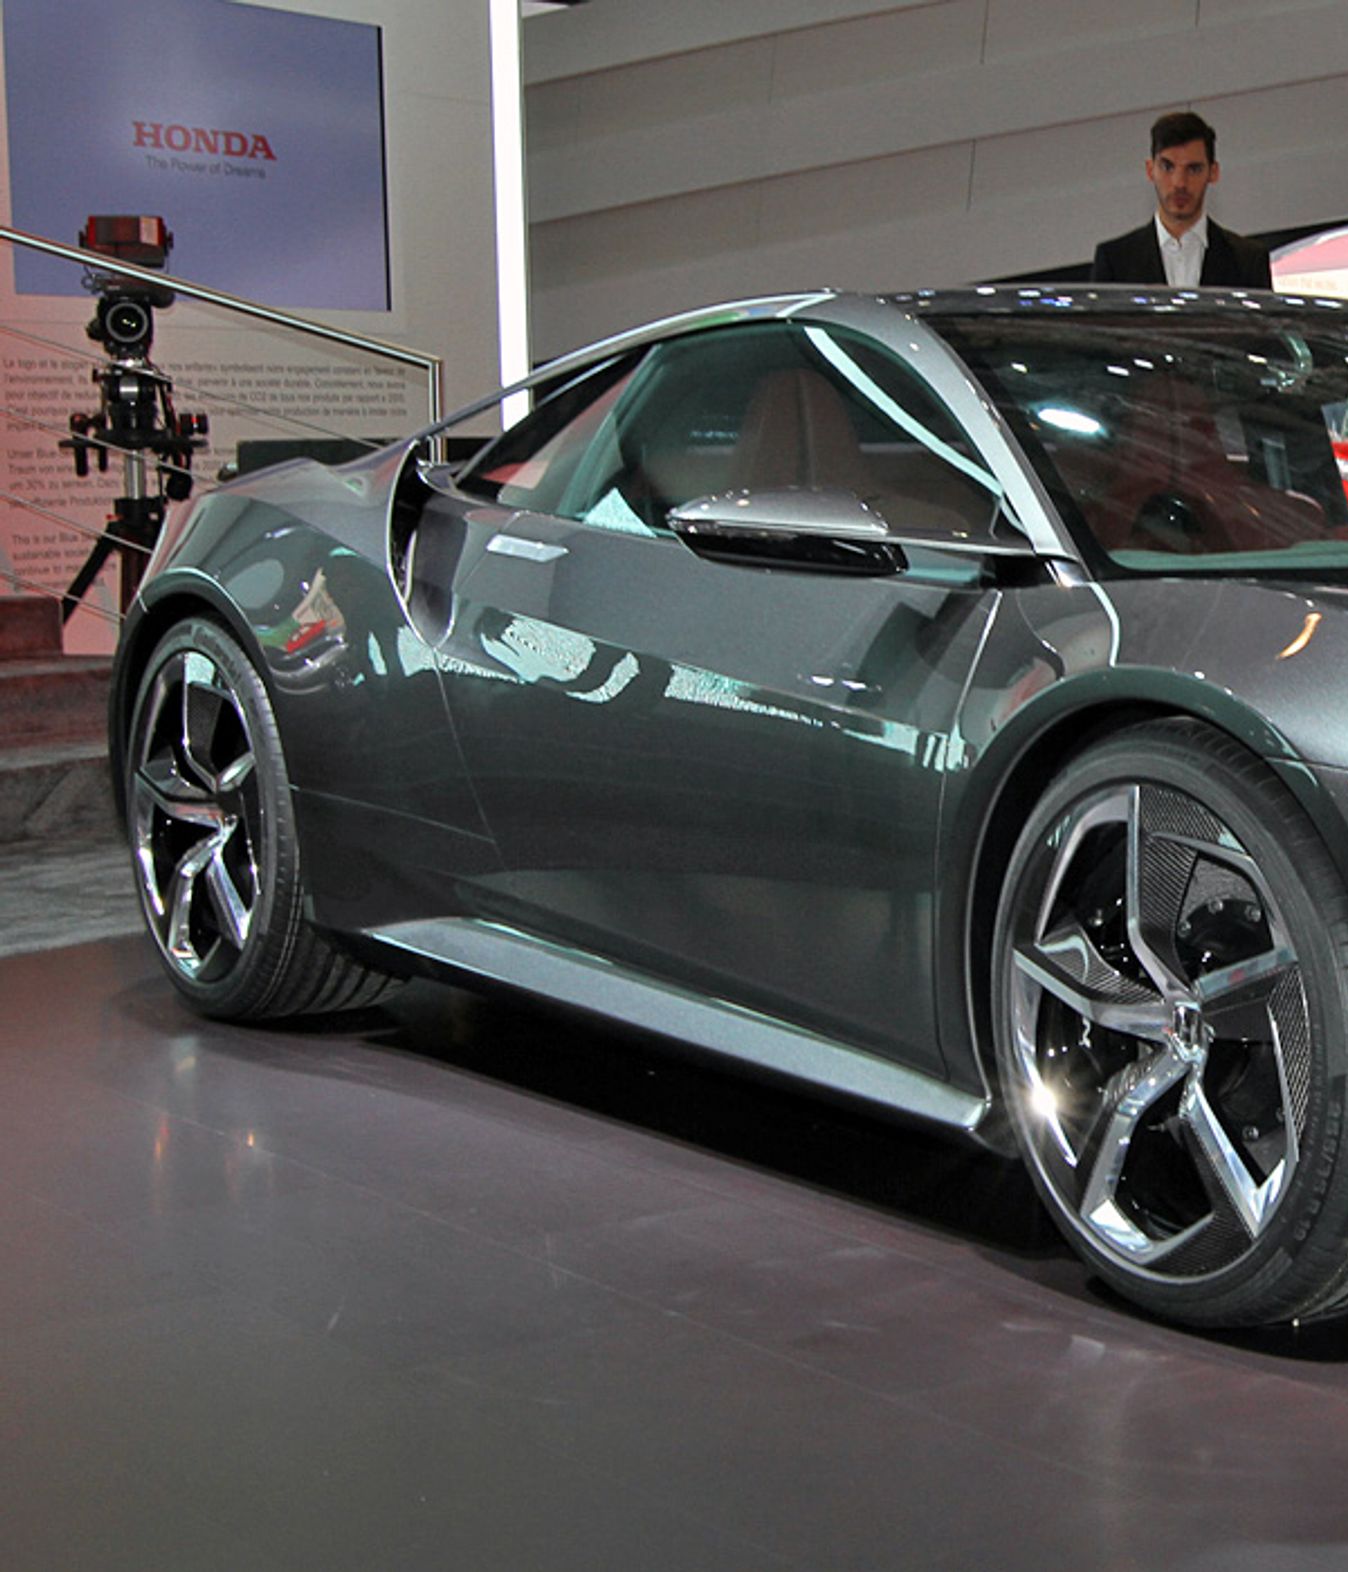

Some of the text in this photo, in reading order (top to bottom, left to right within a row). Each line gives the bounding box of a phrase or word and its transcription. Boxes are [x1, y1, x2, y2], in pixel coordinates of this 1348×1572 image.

[132, 121, 277, 161] HONDA
[145, 155, 266, 178] The Power of Dreams
